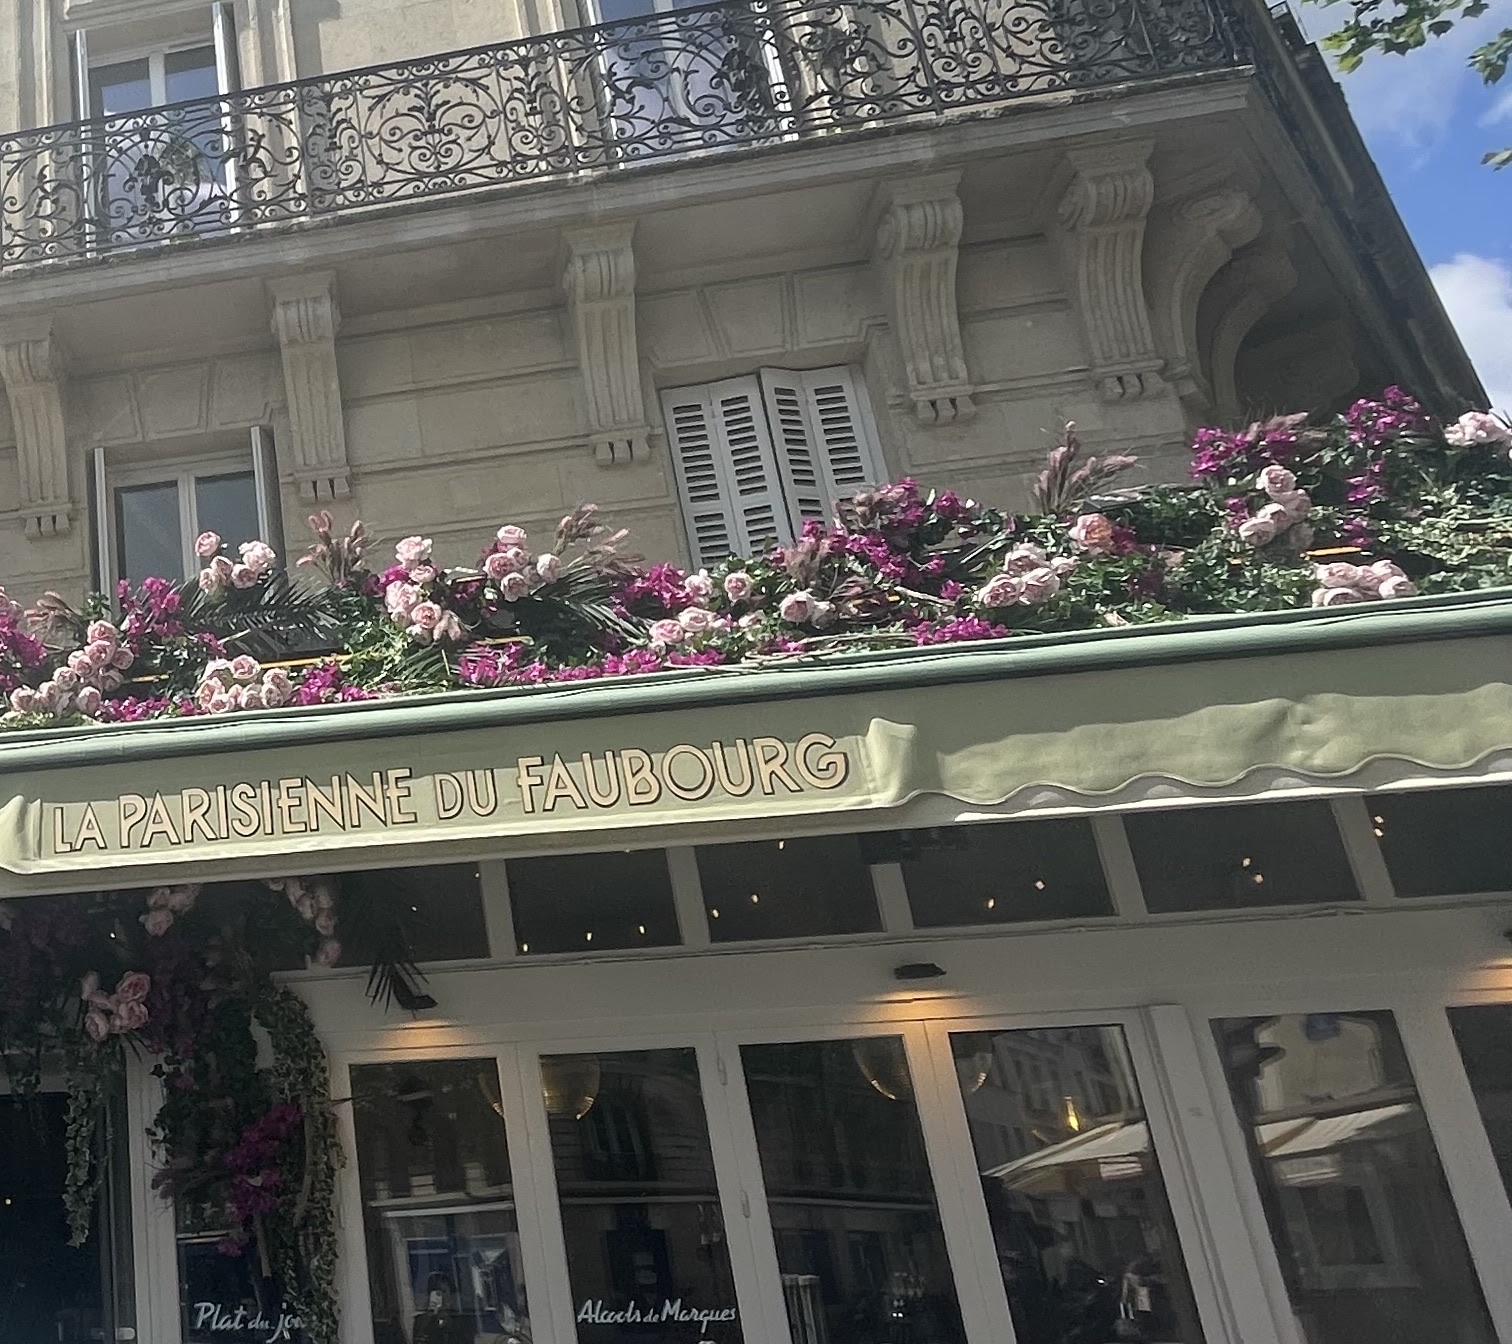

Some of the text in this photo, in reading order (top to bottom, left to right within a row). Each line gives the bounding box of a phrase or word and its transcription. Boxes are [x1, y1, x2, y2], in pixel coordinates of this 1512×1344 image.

[53, 732, 849, 854] LA PARISIENNE DU FAUBOURG
[193, 1302, 248, 1331] Plat
[248, 1311, 271, 1330] du
[643, 1308, 660, 1323] de
[661, 1298, 736, 1333] Marques
